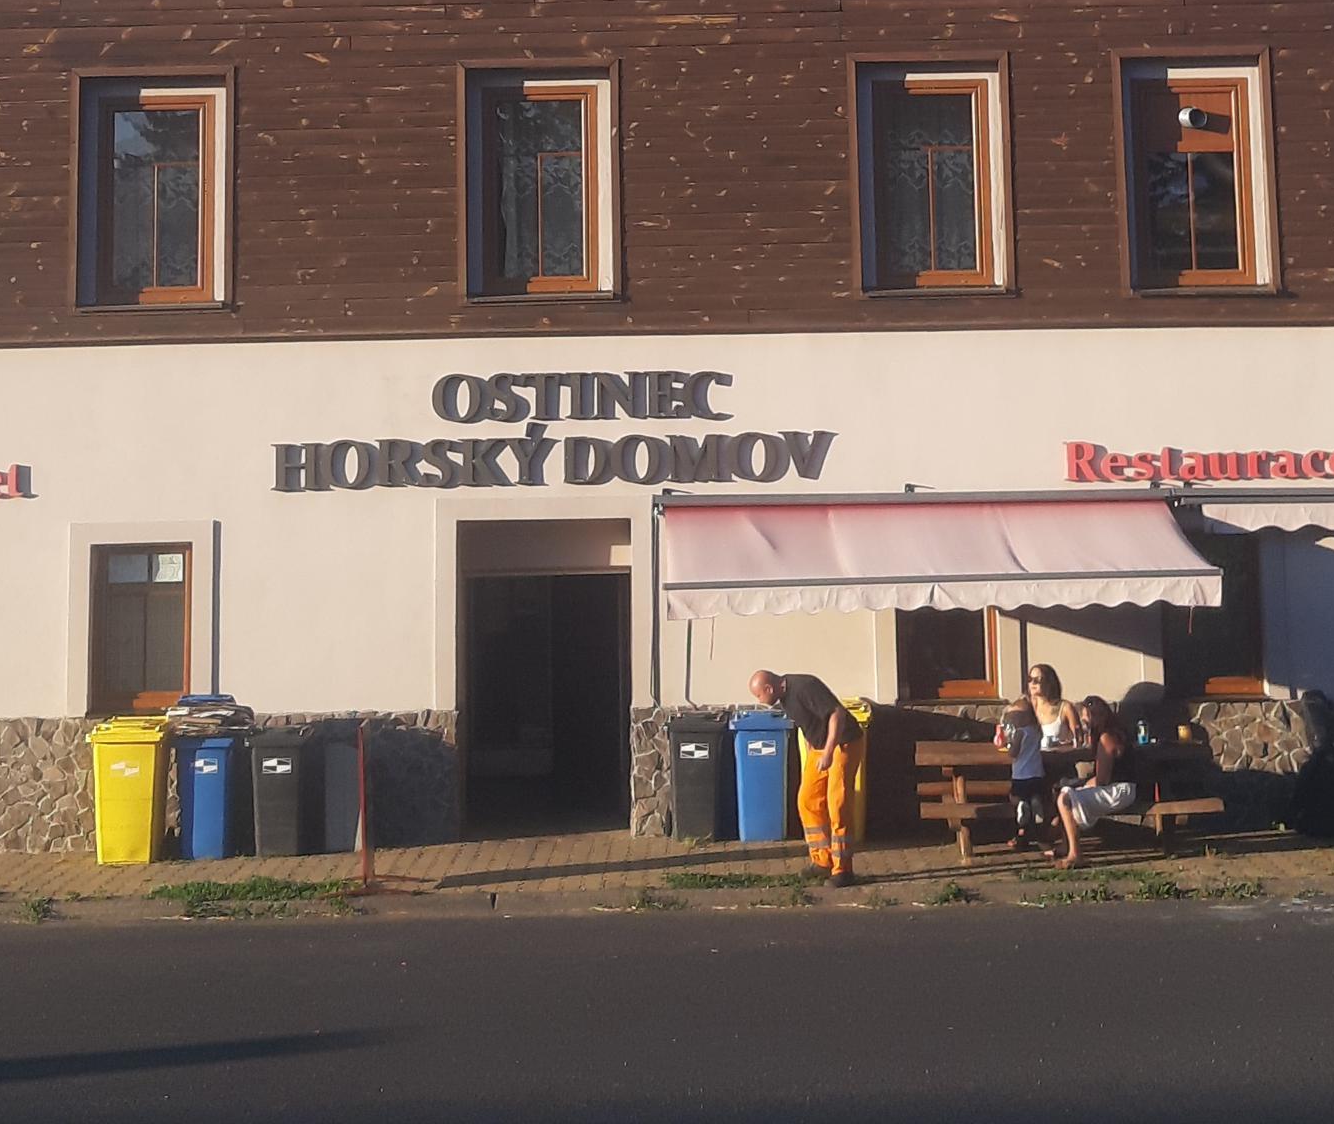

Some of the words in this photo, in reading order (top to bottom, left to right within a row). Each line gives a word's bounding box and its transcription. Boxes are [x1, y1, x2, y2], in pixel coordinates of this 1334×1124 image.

[432, 371, 733, 422] OSTINEC
[271, 424, 559, 491] HORSKÝ
[564, 431, 839, 485] DOMOV
